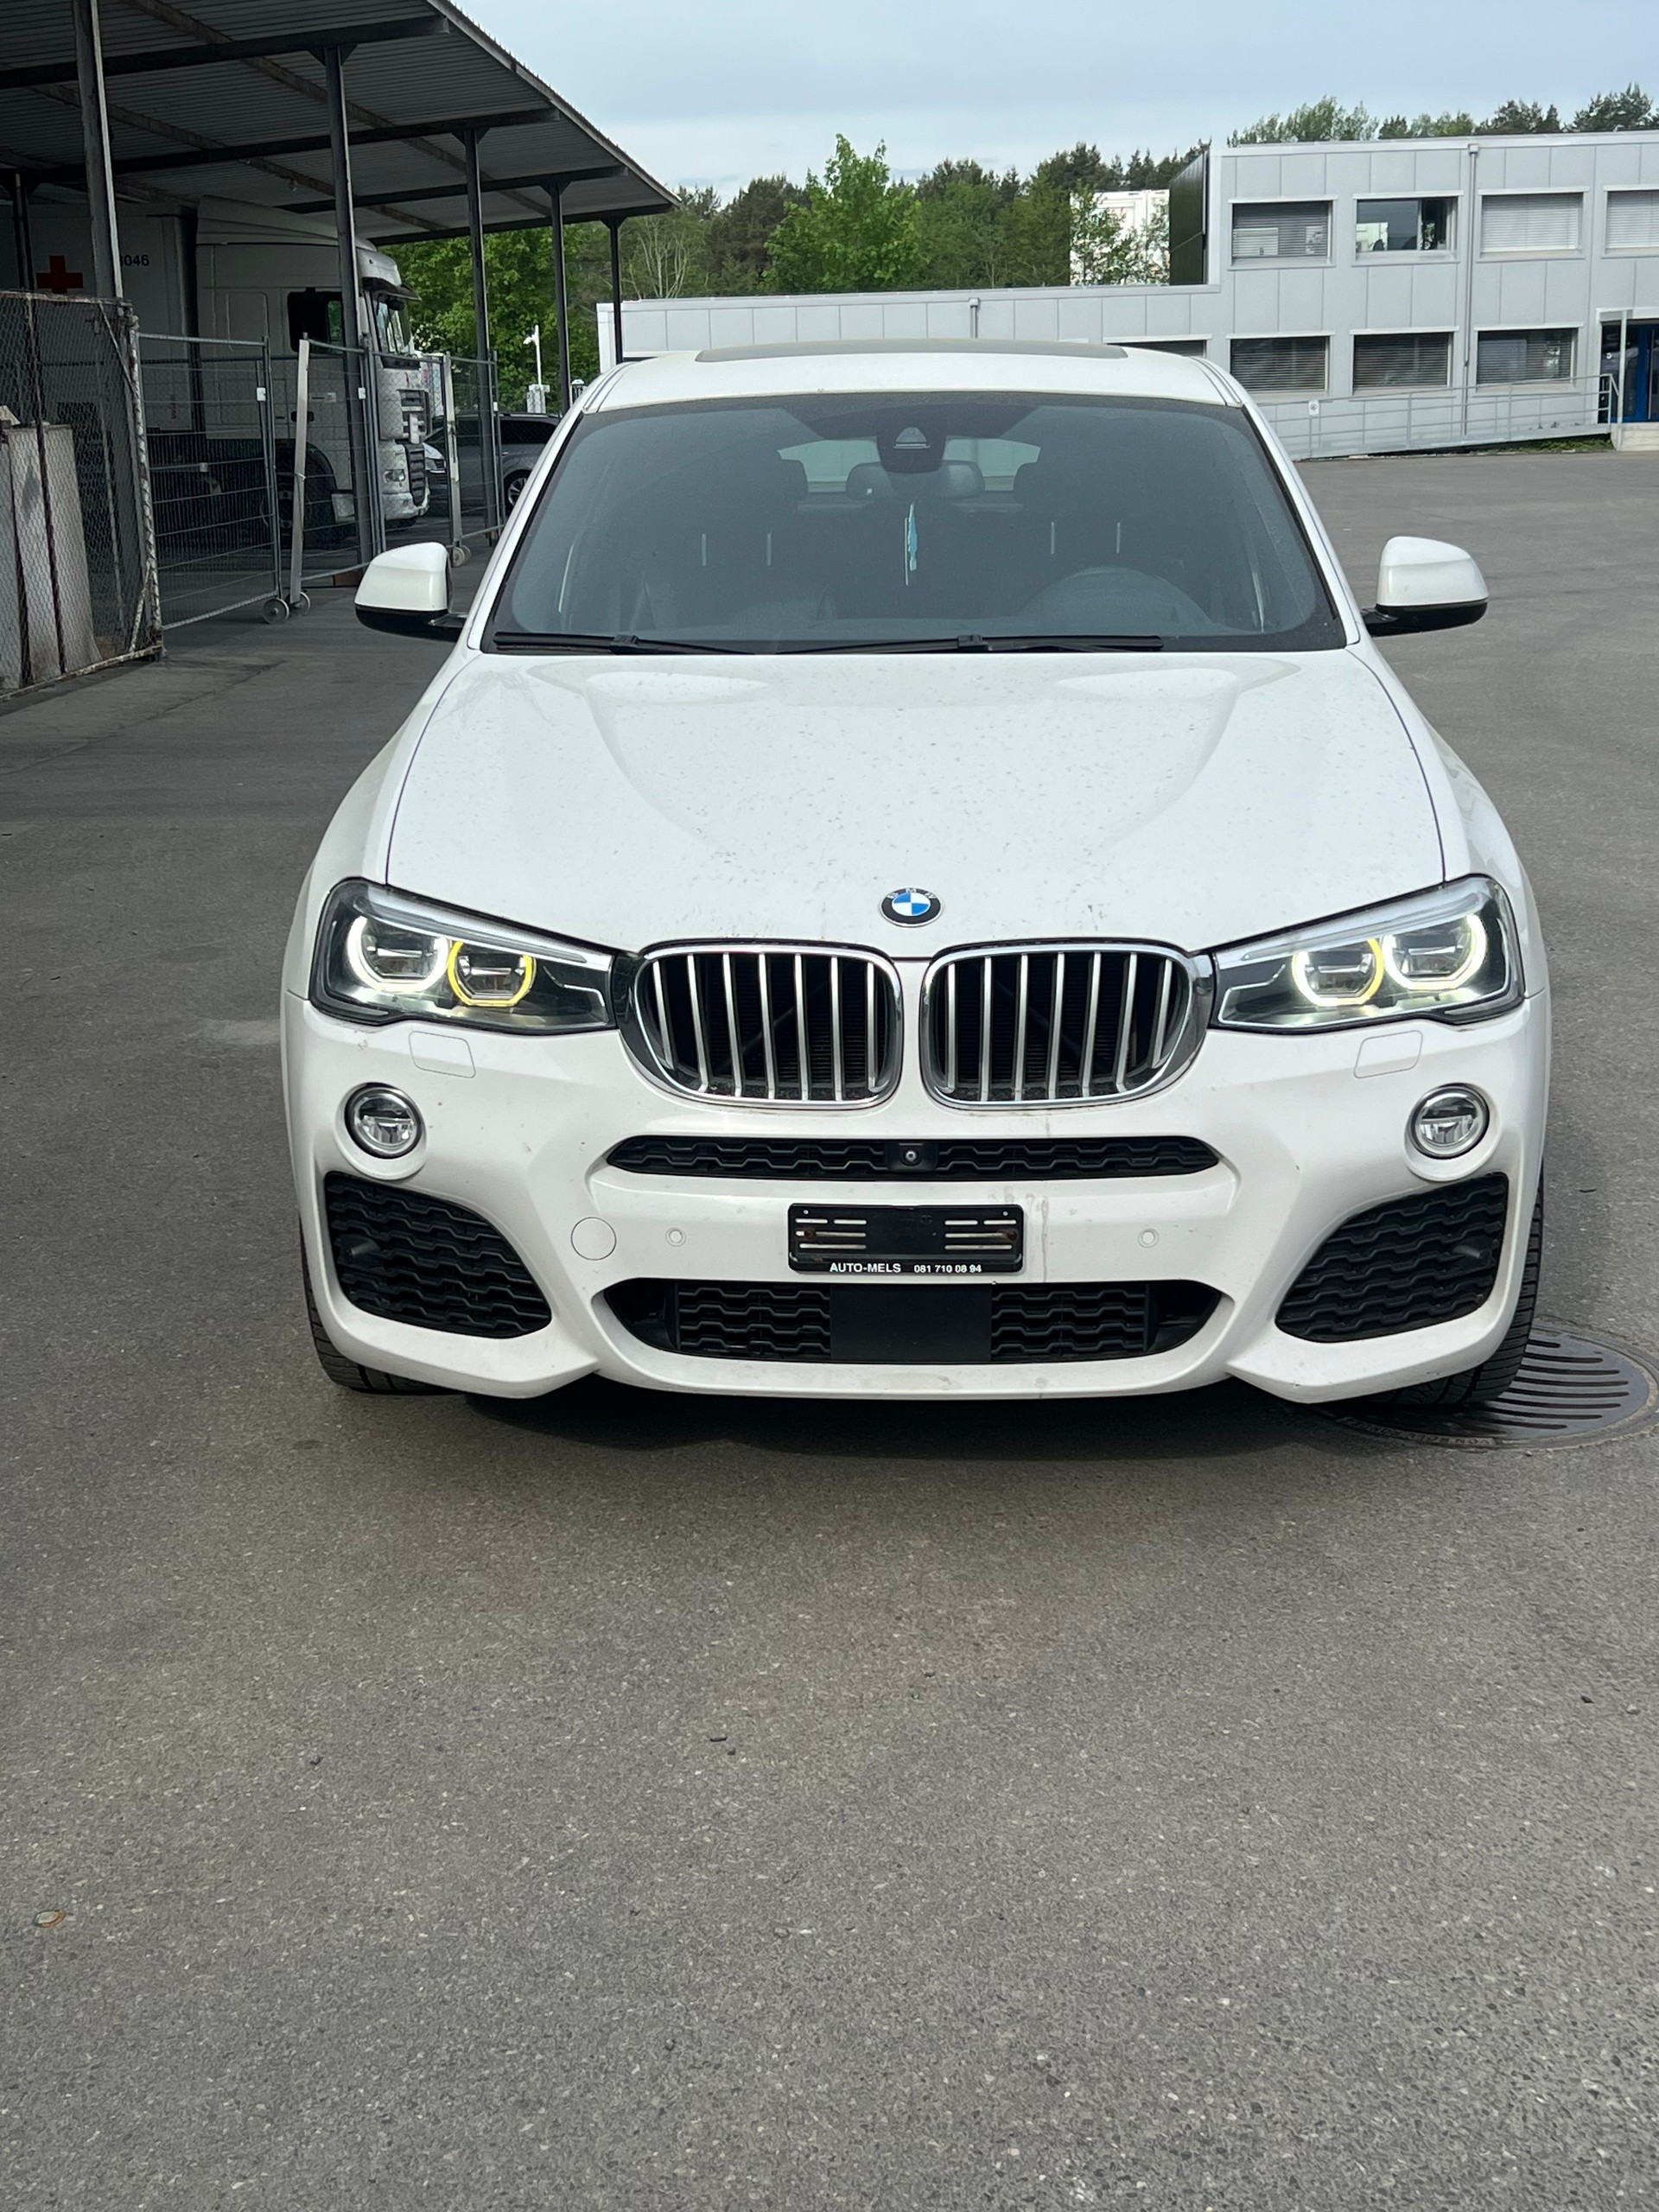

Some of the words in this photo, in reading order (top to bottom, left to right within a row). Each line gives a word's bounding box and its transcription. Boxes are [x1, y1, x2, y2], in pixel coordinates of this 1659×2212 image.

[886, 887, 937, 899] BMW
[829, 1262, 902, 1274] AUTO-MELS
[913, 1264, 931, 1274] 081
[935, 1264, 953, 1274] 710
[954, 1264, 968, 1274] 08
[969, 1264, 982, 1274] 94
